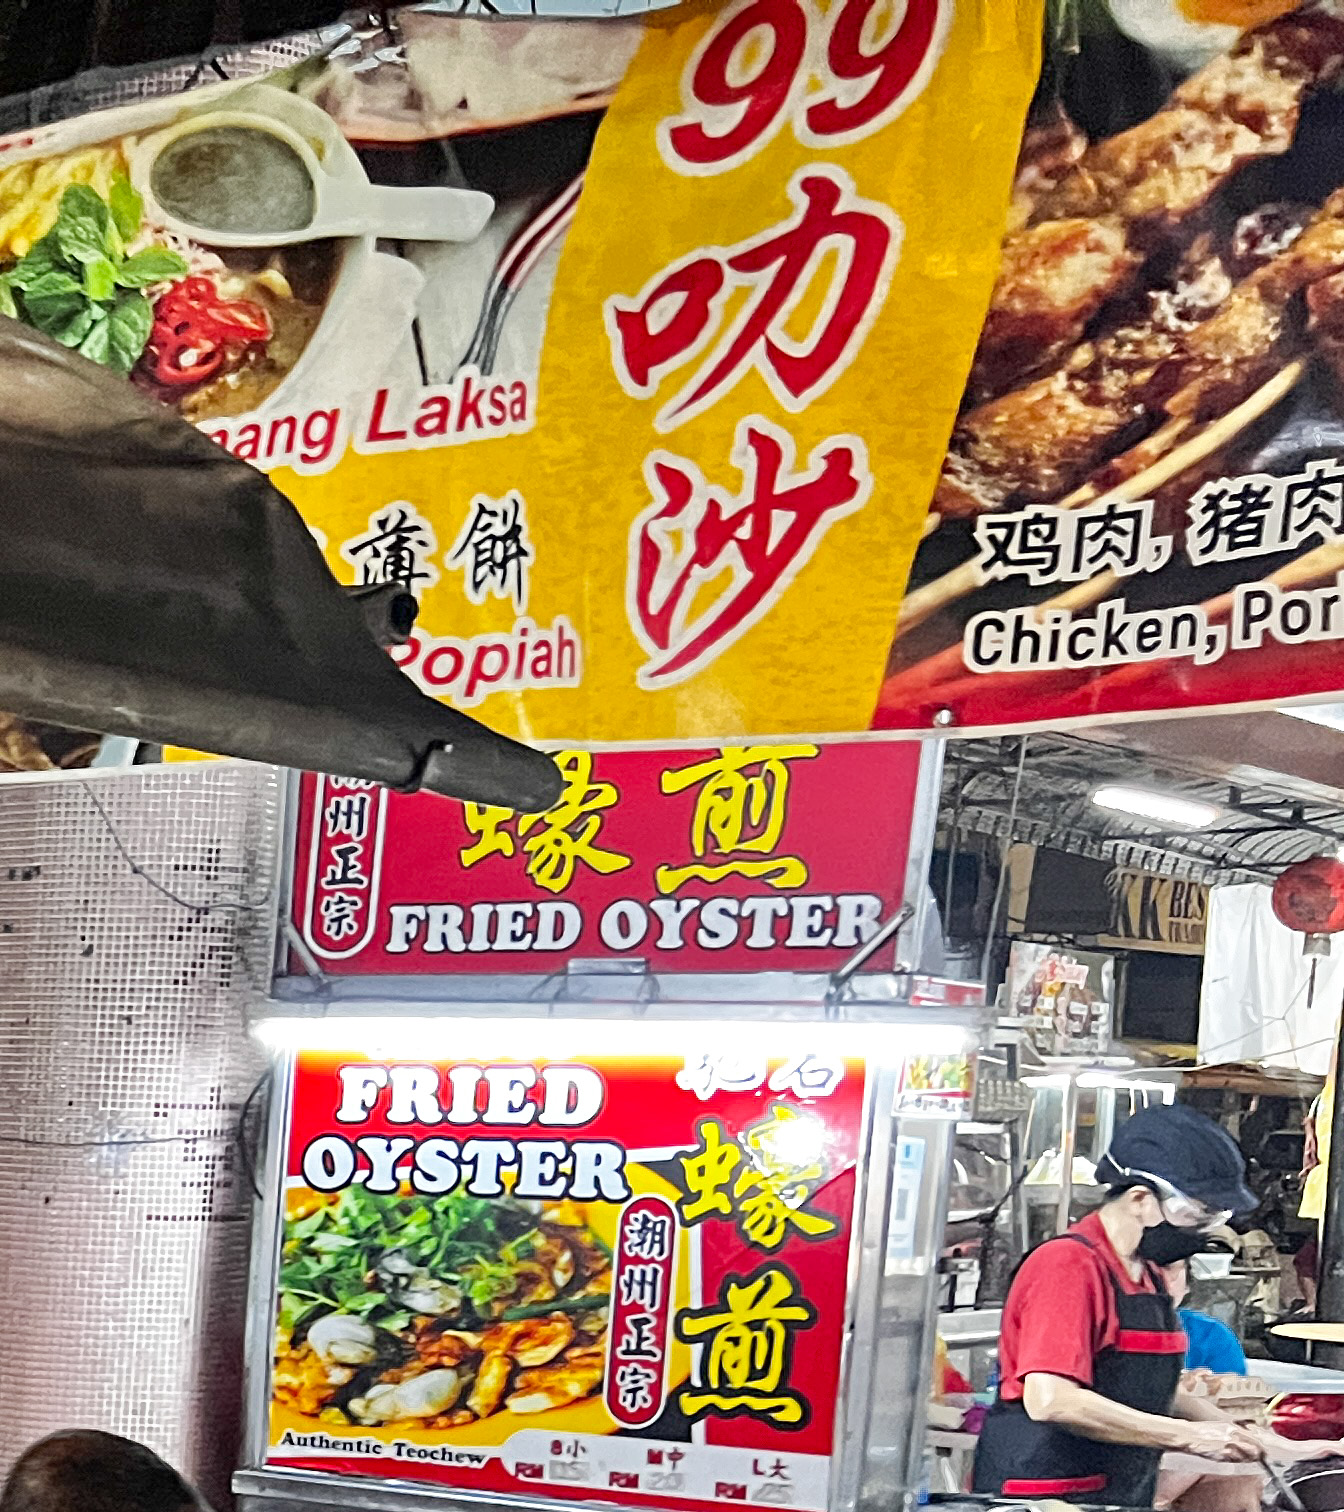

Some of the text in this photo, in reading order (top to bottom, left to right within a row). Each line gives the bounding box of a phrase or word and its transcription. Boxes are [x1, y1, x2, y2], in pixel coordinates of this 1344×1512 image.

[365, 377, 528, 443] Laksa
[972, 606, 1218, 667] Chicken,
[323, 776, 370, 937] 州正宗
[385, 894, 885, 952] FRIED OYSTER
[335, 1065, 604, 1126] FRIED
[302, 1135, 632, 1200] OYSTER
[619, 1213, 668, 1408] 潮州正宗
[281, 1432, 487, 1464] Authentic Teochew
